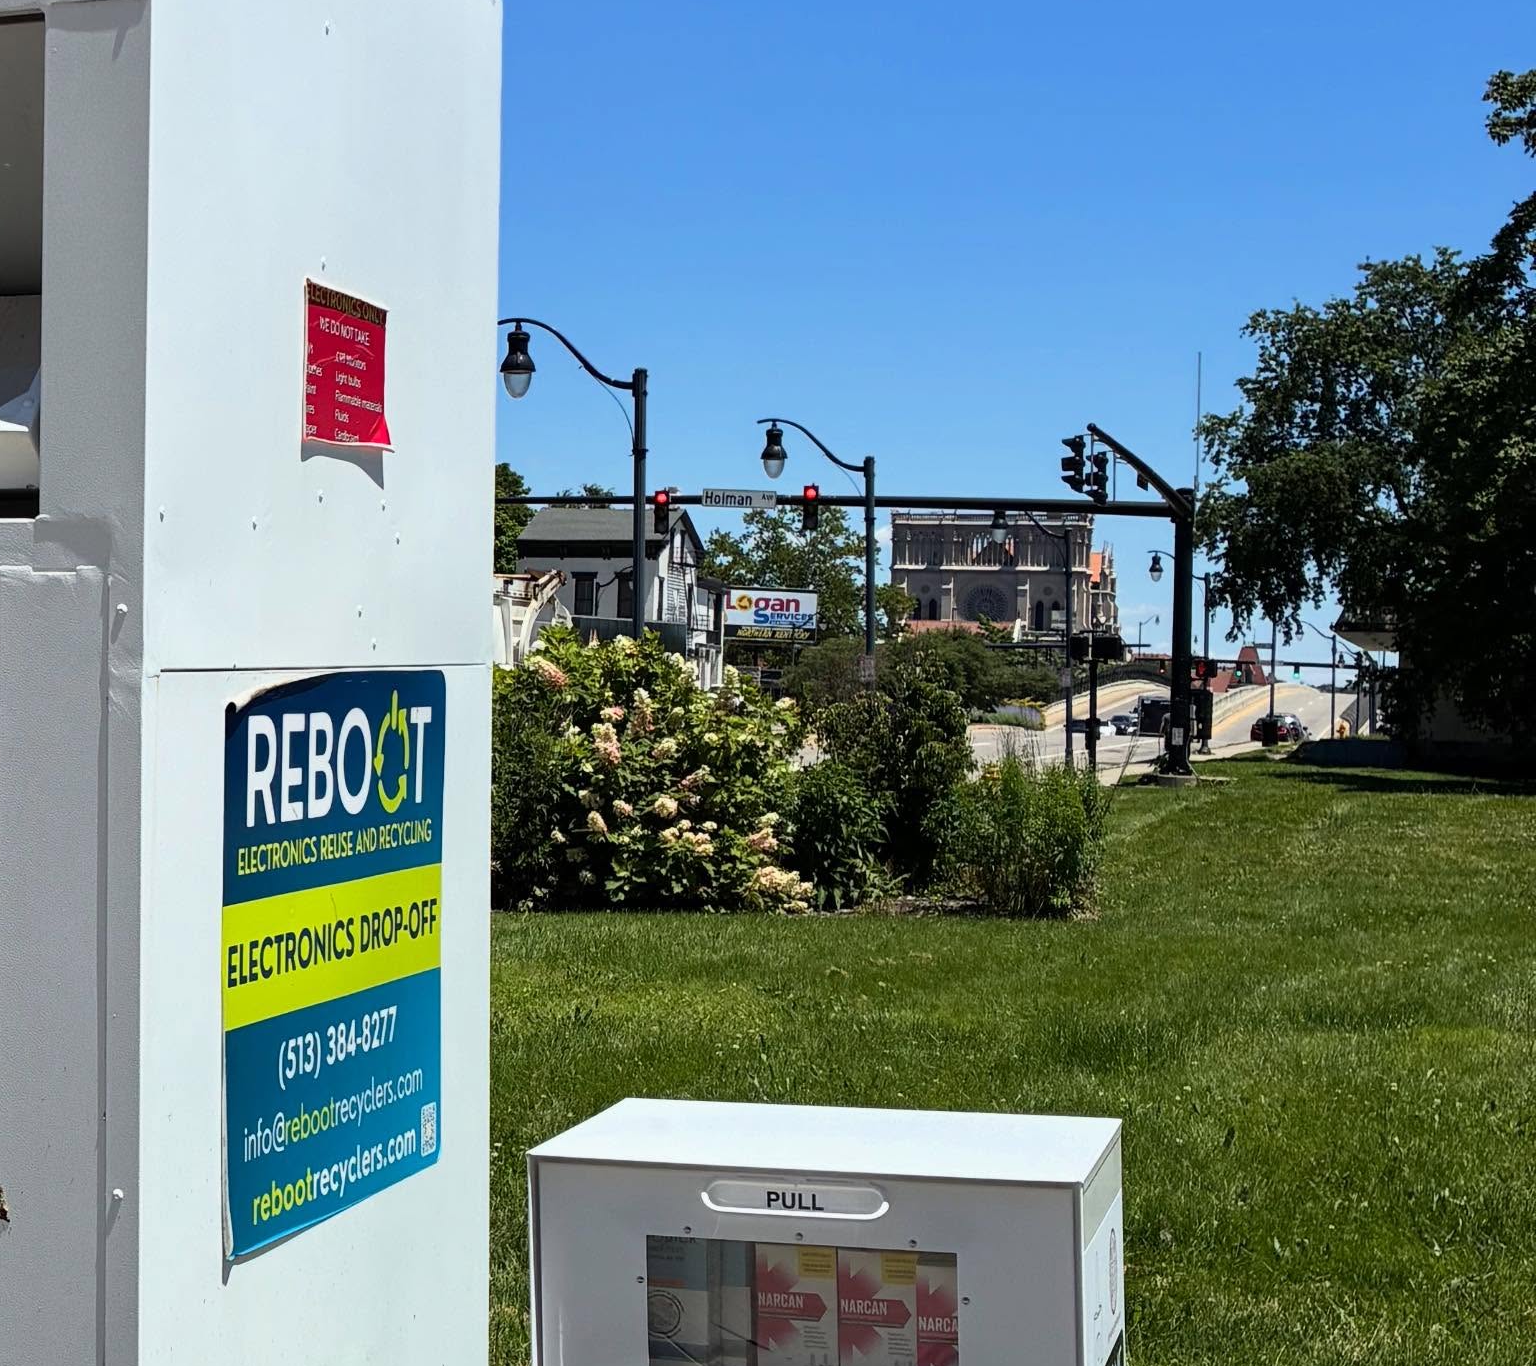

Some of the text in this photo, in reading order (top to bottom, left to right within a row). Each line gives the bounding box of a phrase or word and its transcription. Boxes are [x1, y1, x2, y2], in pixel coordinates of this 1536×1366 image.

[704, 490, 753, 506] Holman
[237, 817, 433, 876] ELECTRONICS REUSE AND RECYCLING
[227, 897, 438, 990] ELECTRONICS DROP-OFF
[277, 1004, 398, 1091] (513) 384-8277
[242, 1063, 424, 1164] info@rebootrecyclers.com
[251, 1124, 417, 1226] rebootrecyclers.com
[765, 1190, 825, 1212] PULL
[757, 1292, 804, 1309] NARCAN
[840, 1299, 888, 1316] NARCAN
[918, 1316, 959, 1333] NARCA
